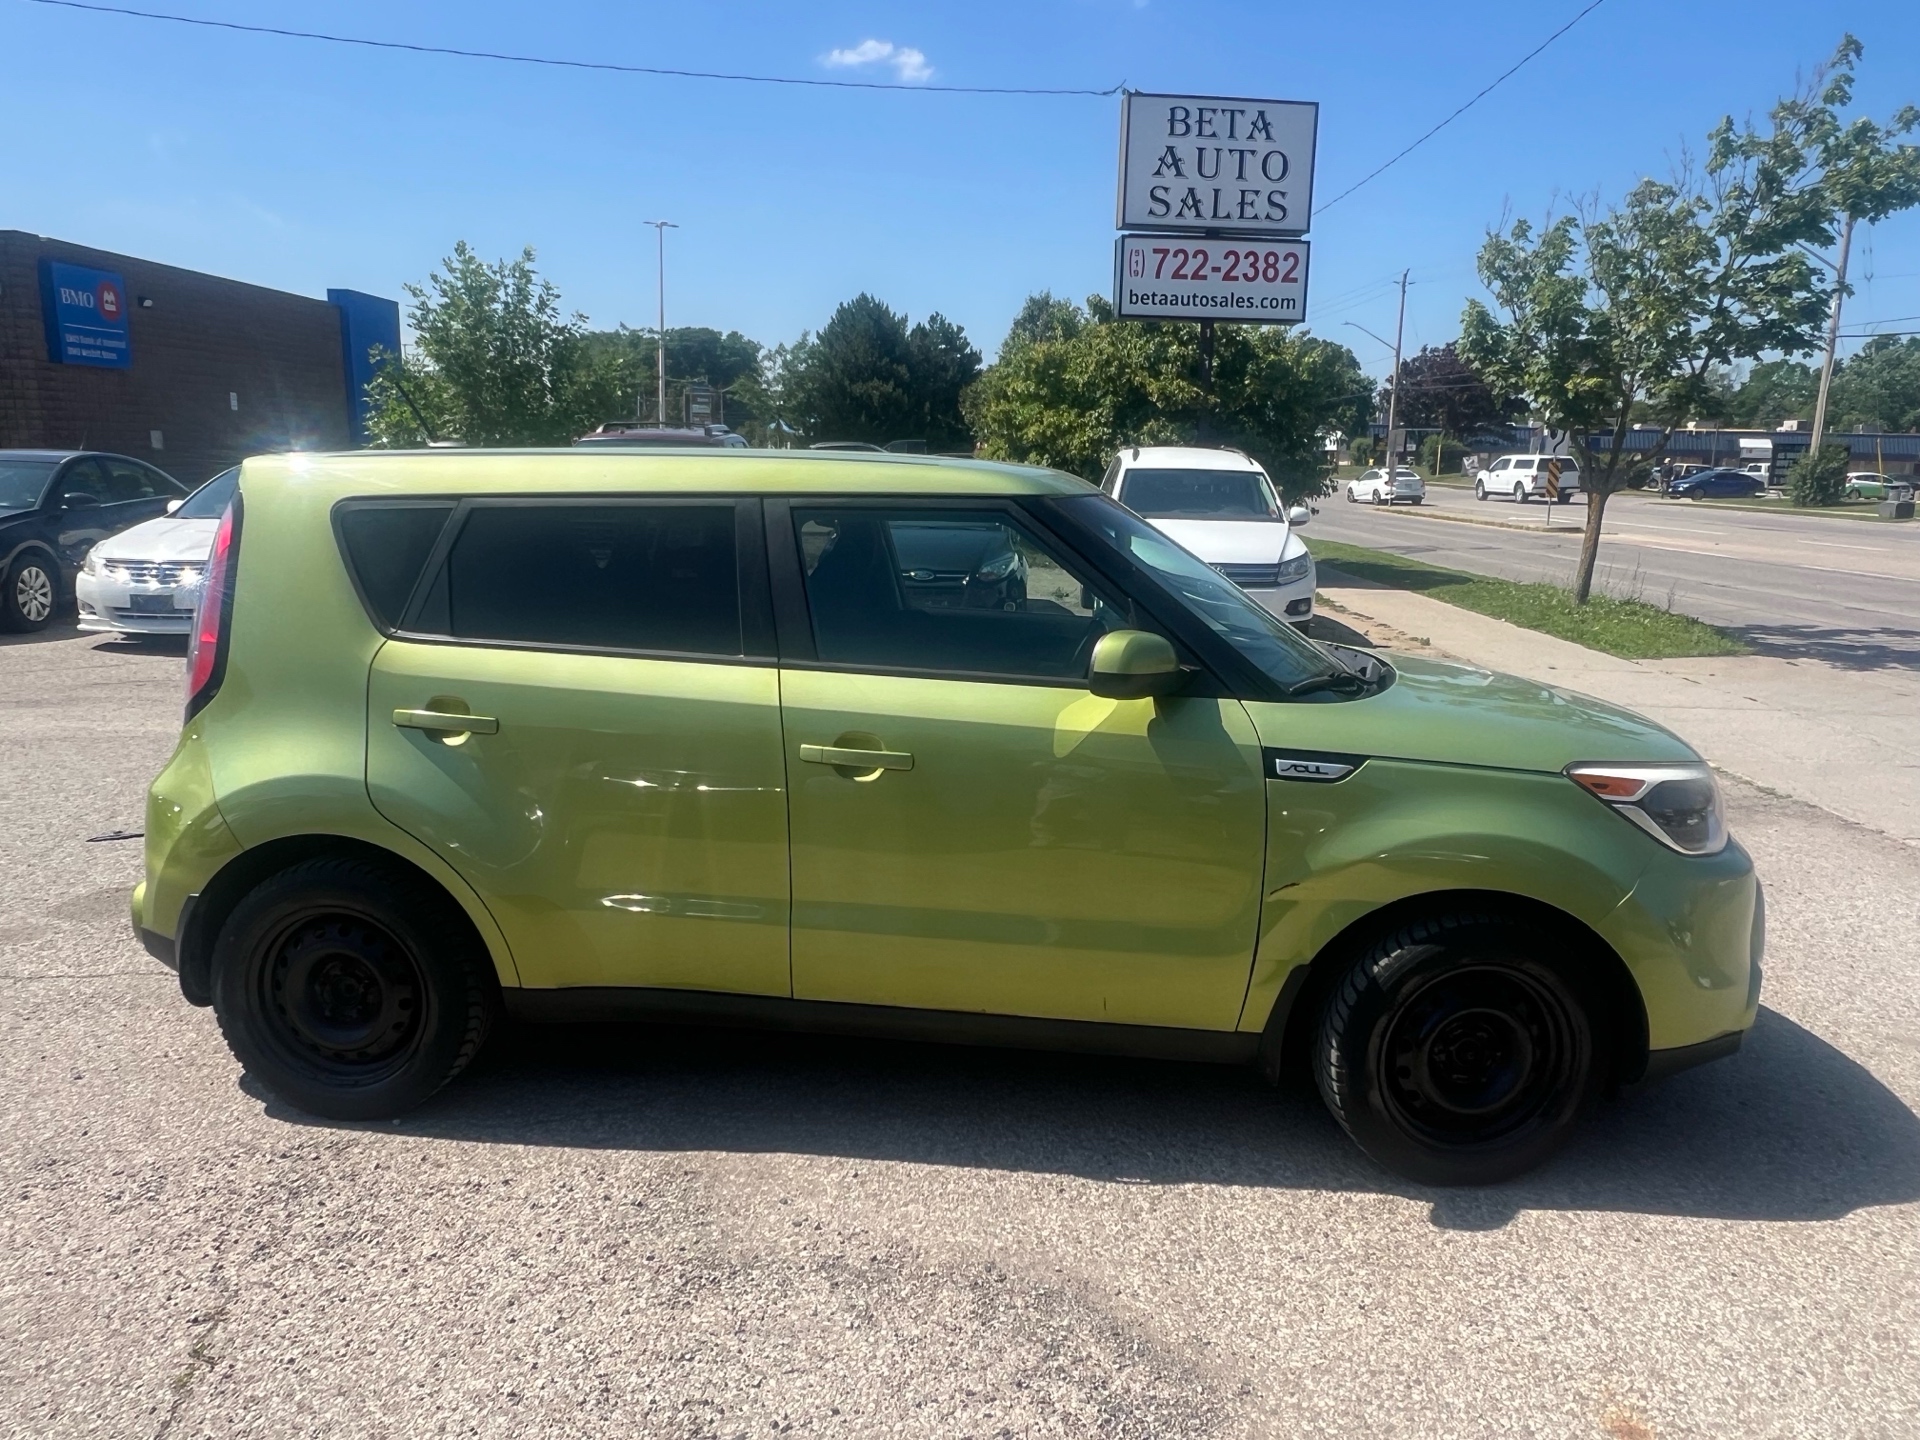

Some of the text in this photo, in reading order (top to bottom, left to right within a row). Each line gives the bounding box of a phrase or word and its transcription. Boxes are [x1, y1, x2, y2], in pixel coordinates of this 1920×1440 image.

[1167, 106, 1276, 142] BETA
[1152, 145, 1290, 182] AUTO
[1148, 186, 1289, 223] SALES
[1152, 248, 1300, 284] 722-2382
[60, 287, 94, 308] BMO
[1129, 289, 1296, 310] betaautosales.com
